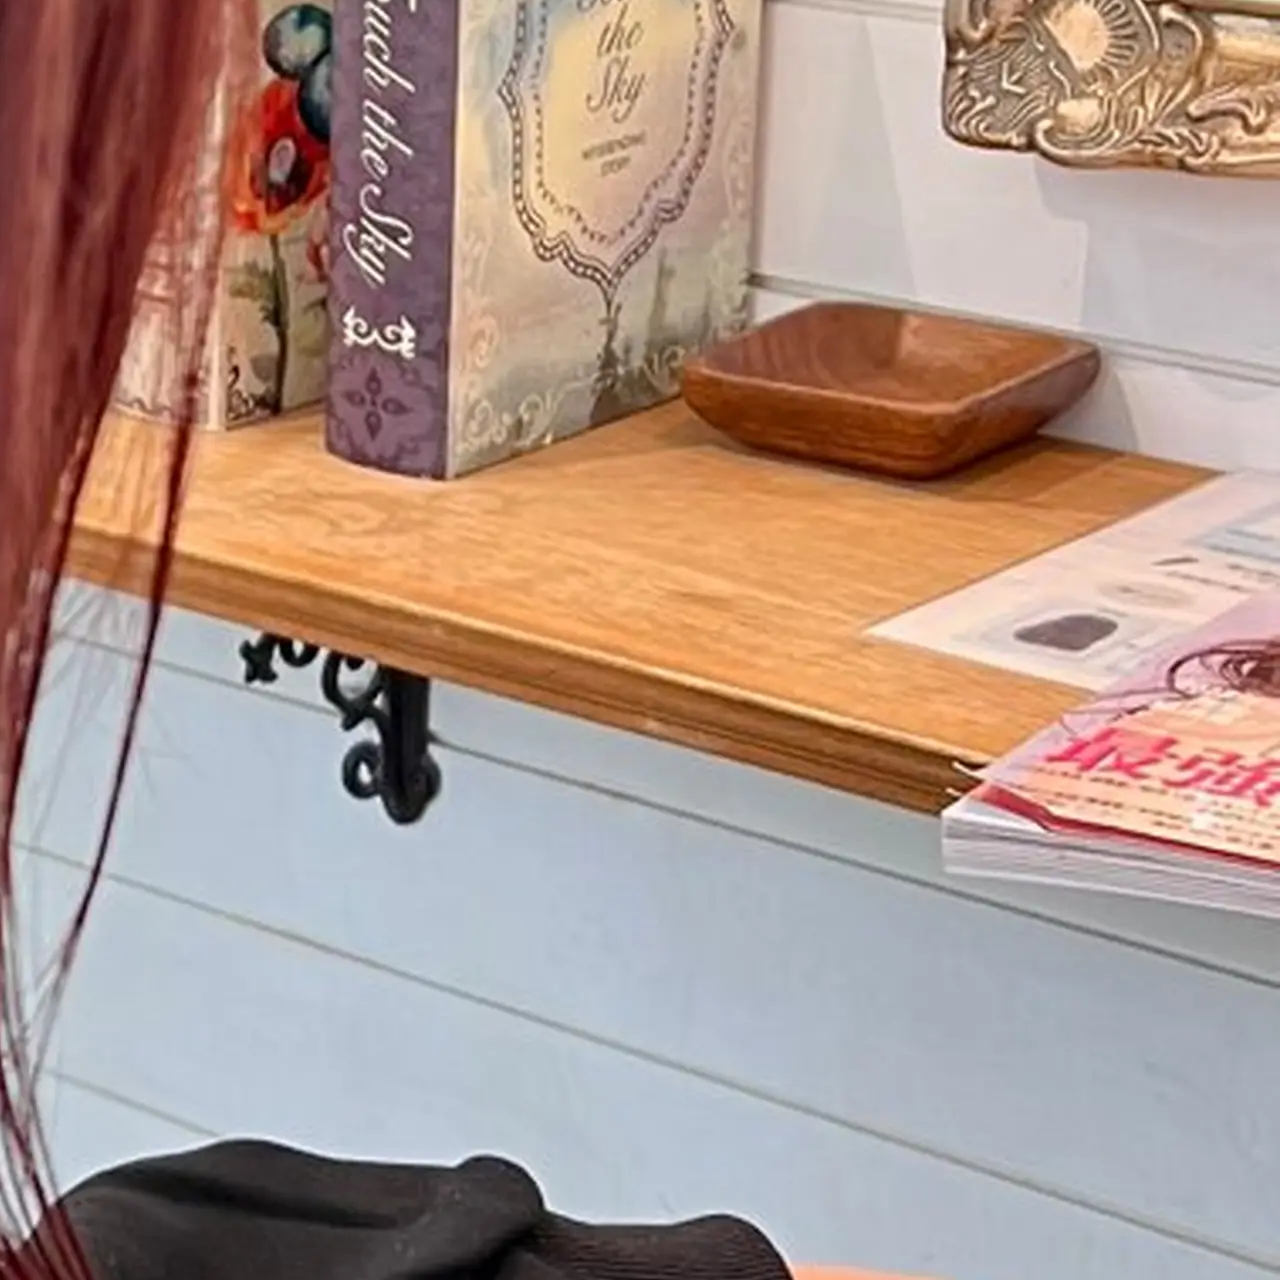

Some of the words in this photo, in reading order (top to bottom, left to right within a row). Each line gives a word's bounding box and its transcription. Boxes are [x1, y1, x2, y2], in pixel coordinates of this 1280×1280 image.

[596, 3, 643, 58] the
[585, 54, 646, 124] Sky
[360, 98, 416, 184] the
[342, 184, 415, 289] Sky
